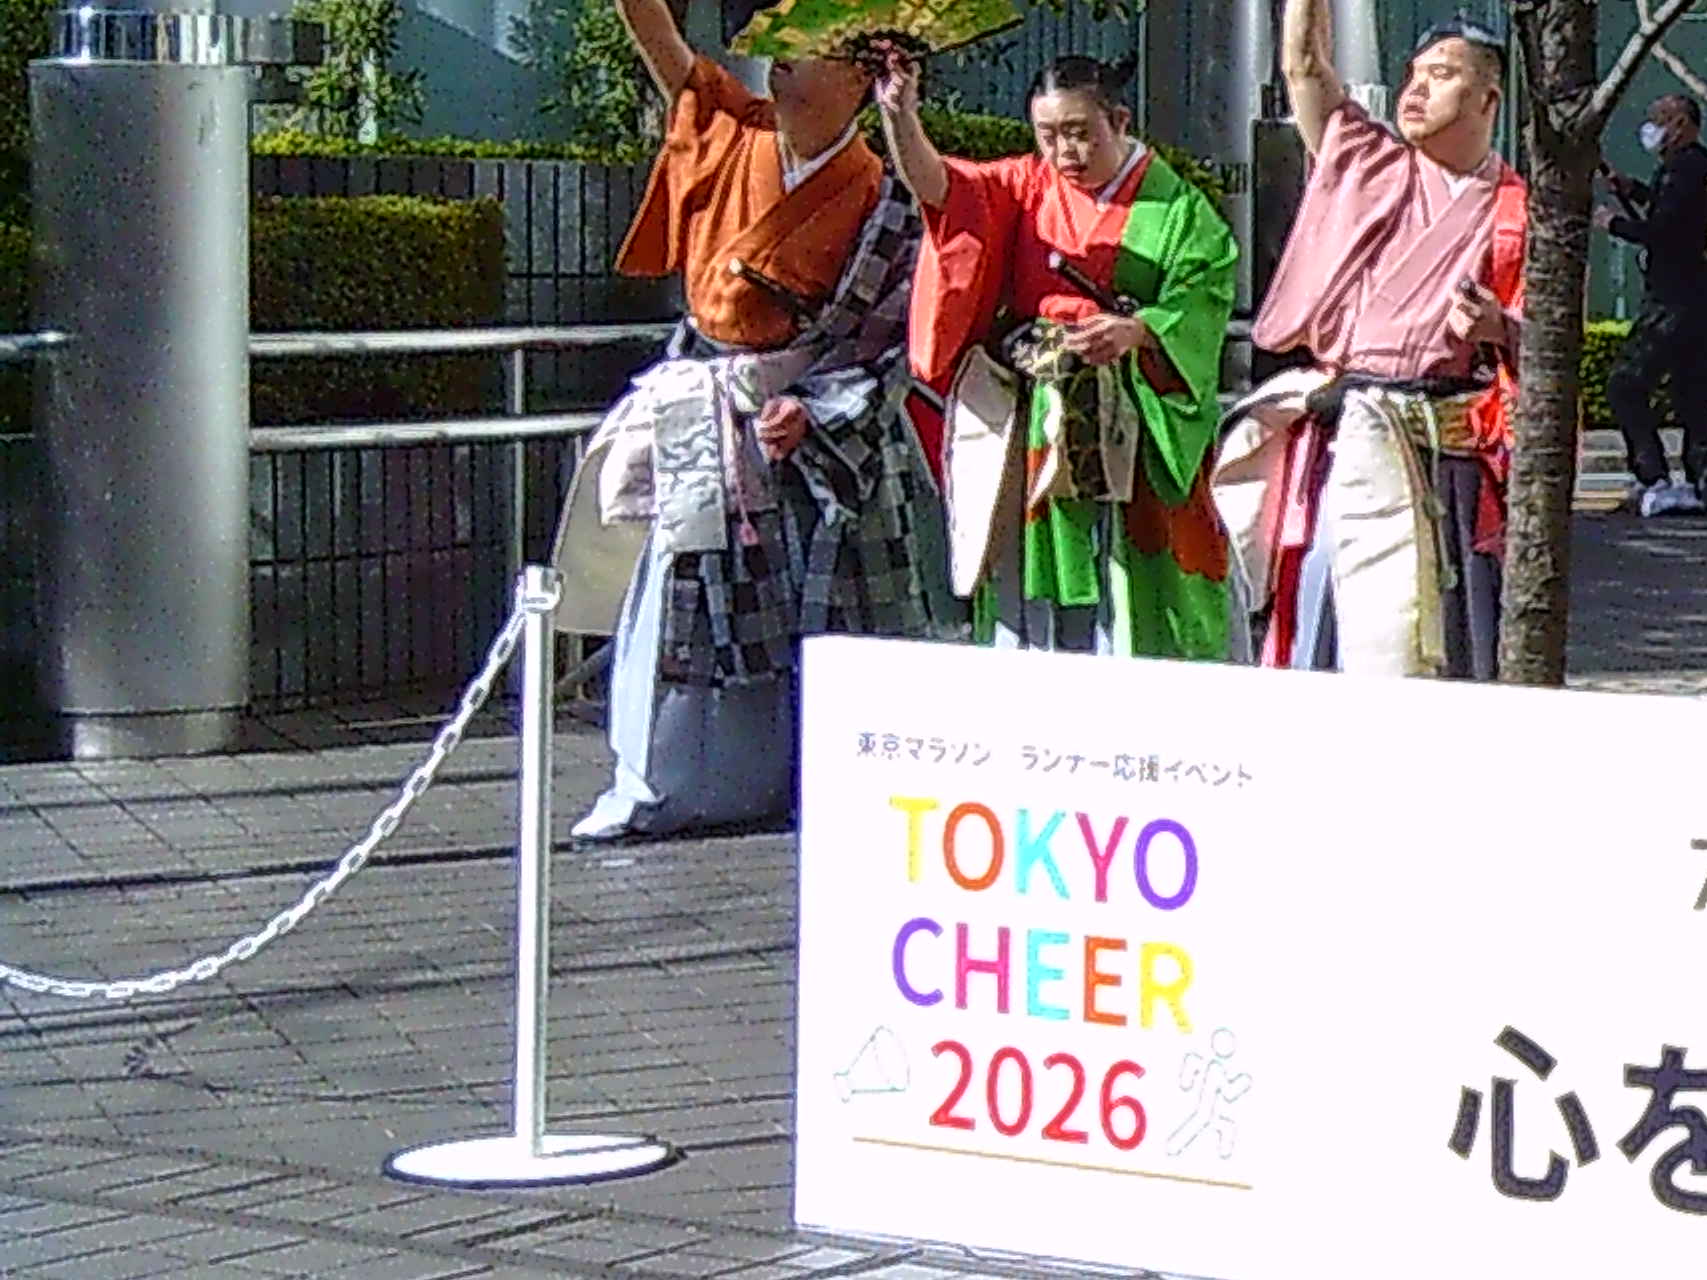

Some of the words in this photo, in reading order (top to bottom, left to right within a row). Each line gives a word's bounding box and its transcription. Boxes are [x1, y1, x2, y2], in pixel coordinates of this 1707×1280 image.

[855, 730, 992, 768] 東京マラソン
[1020, 743, 1254, 788] ランナー応援イベント
[888, 795, 1199, 911] TOKYO
[891, 916, 1196, 1033] CHEER
[928, 1039, 1148, 1151] 2026
